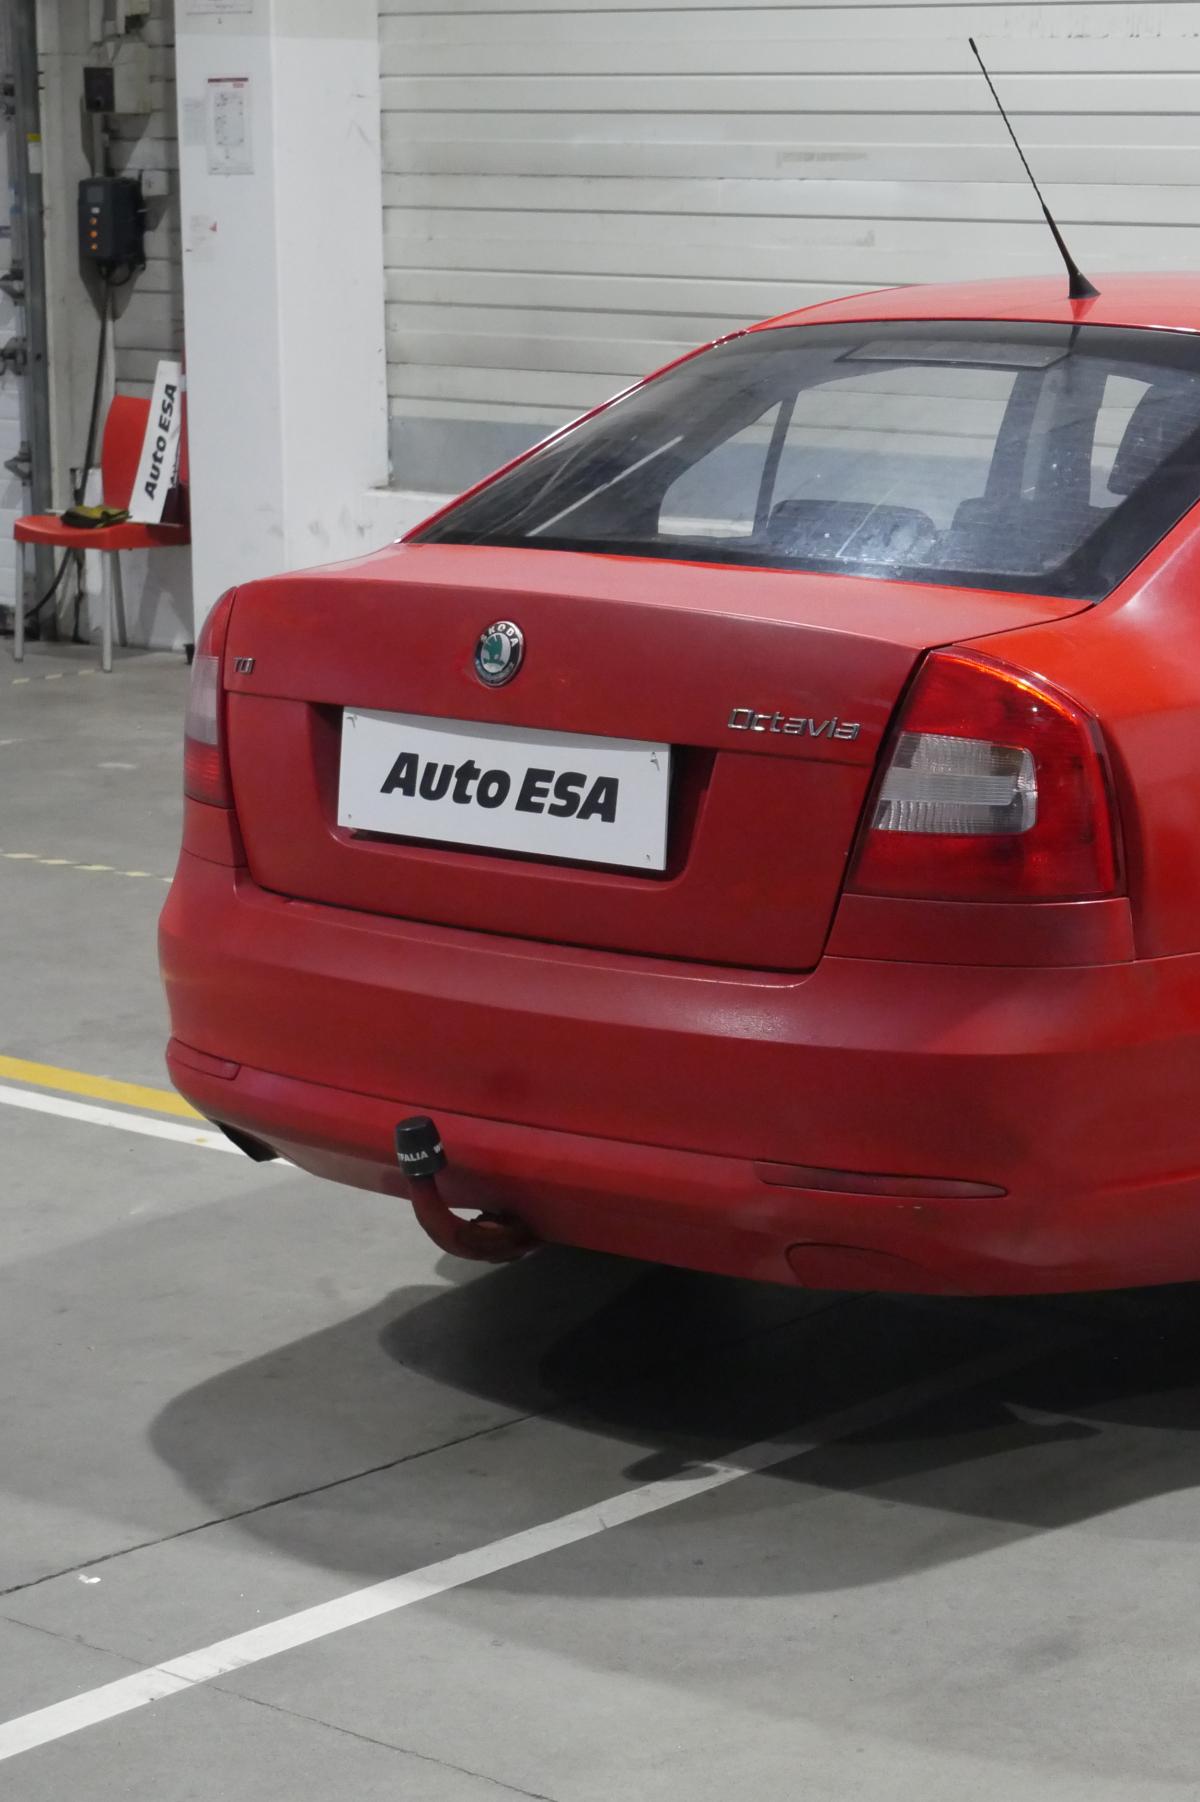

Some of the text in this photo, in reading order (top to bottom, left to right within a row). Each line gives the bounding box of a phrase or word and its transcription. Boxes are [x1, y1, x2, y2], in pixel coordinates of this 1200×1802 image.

[144, 384, 177, 500] Auto ESA
[728, 708, 860, 740] Octavia
[380, 751, 619, 823] Auto ESA
